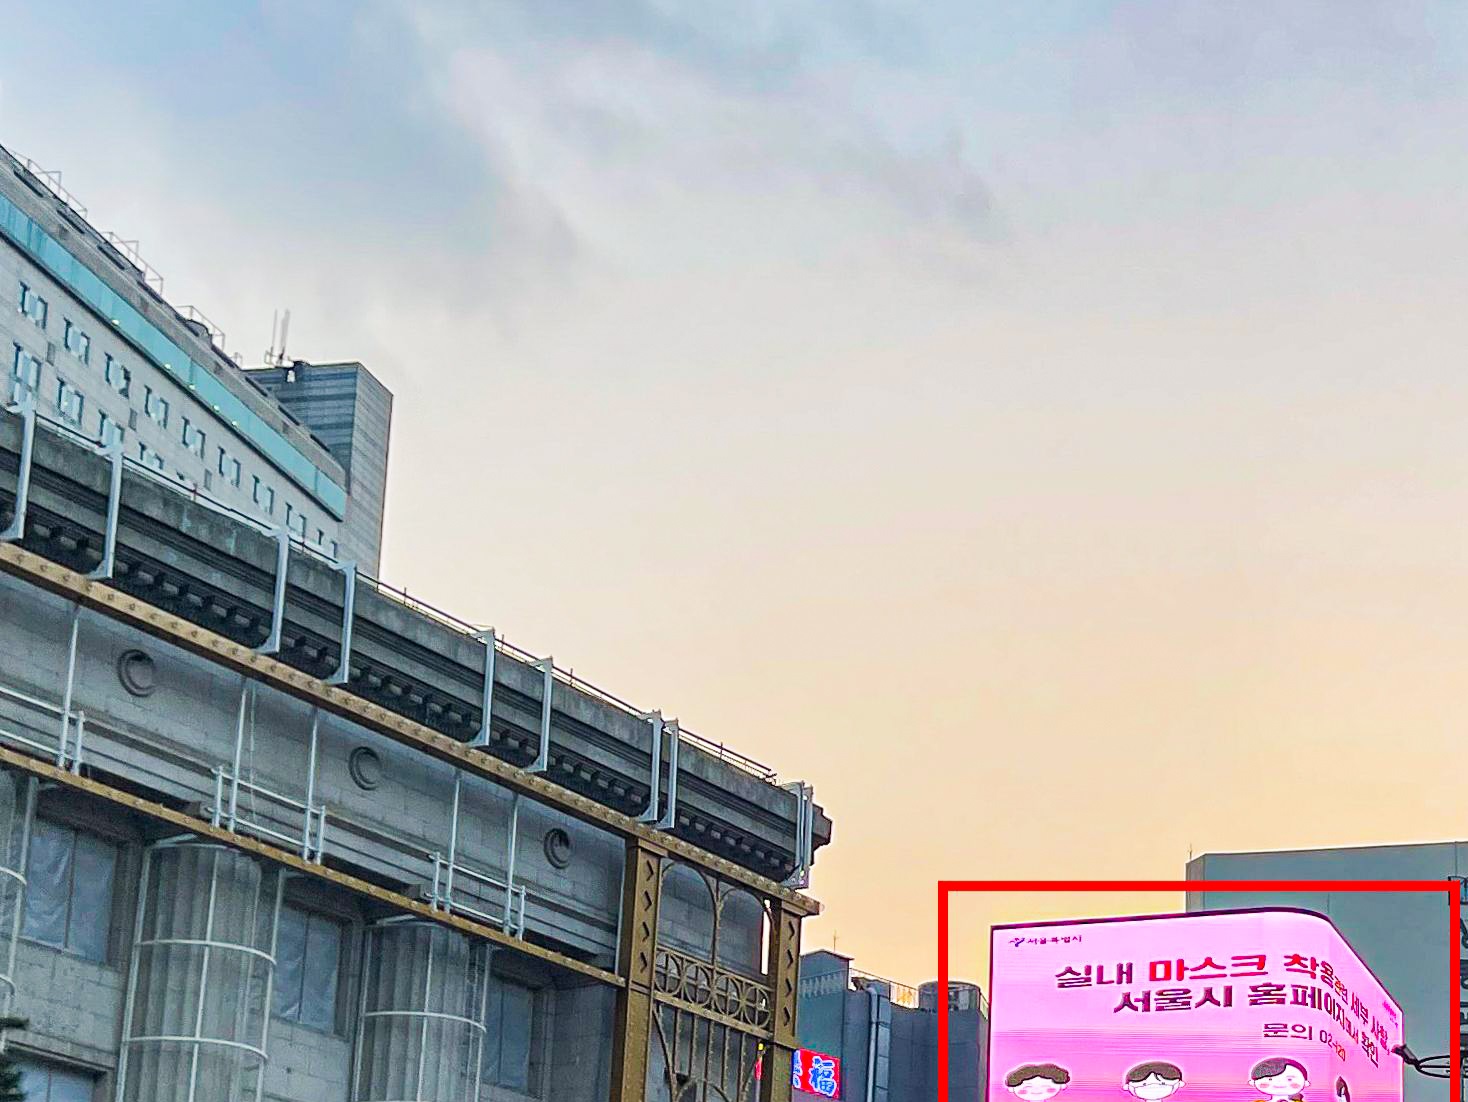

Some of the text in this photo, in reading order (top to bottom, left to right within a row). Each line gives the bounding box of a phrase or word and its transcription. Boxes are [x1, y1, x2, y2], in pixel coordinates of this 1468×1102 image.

[1055, 962, 1133, 988] 실내
[1149, 954, 1268, 982] 마스크
[1113, 984, 1233, 1013] 서울시
[1262, 1022, 1313, 1040] 문의
